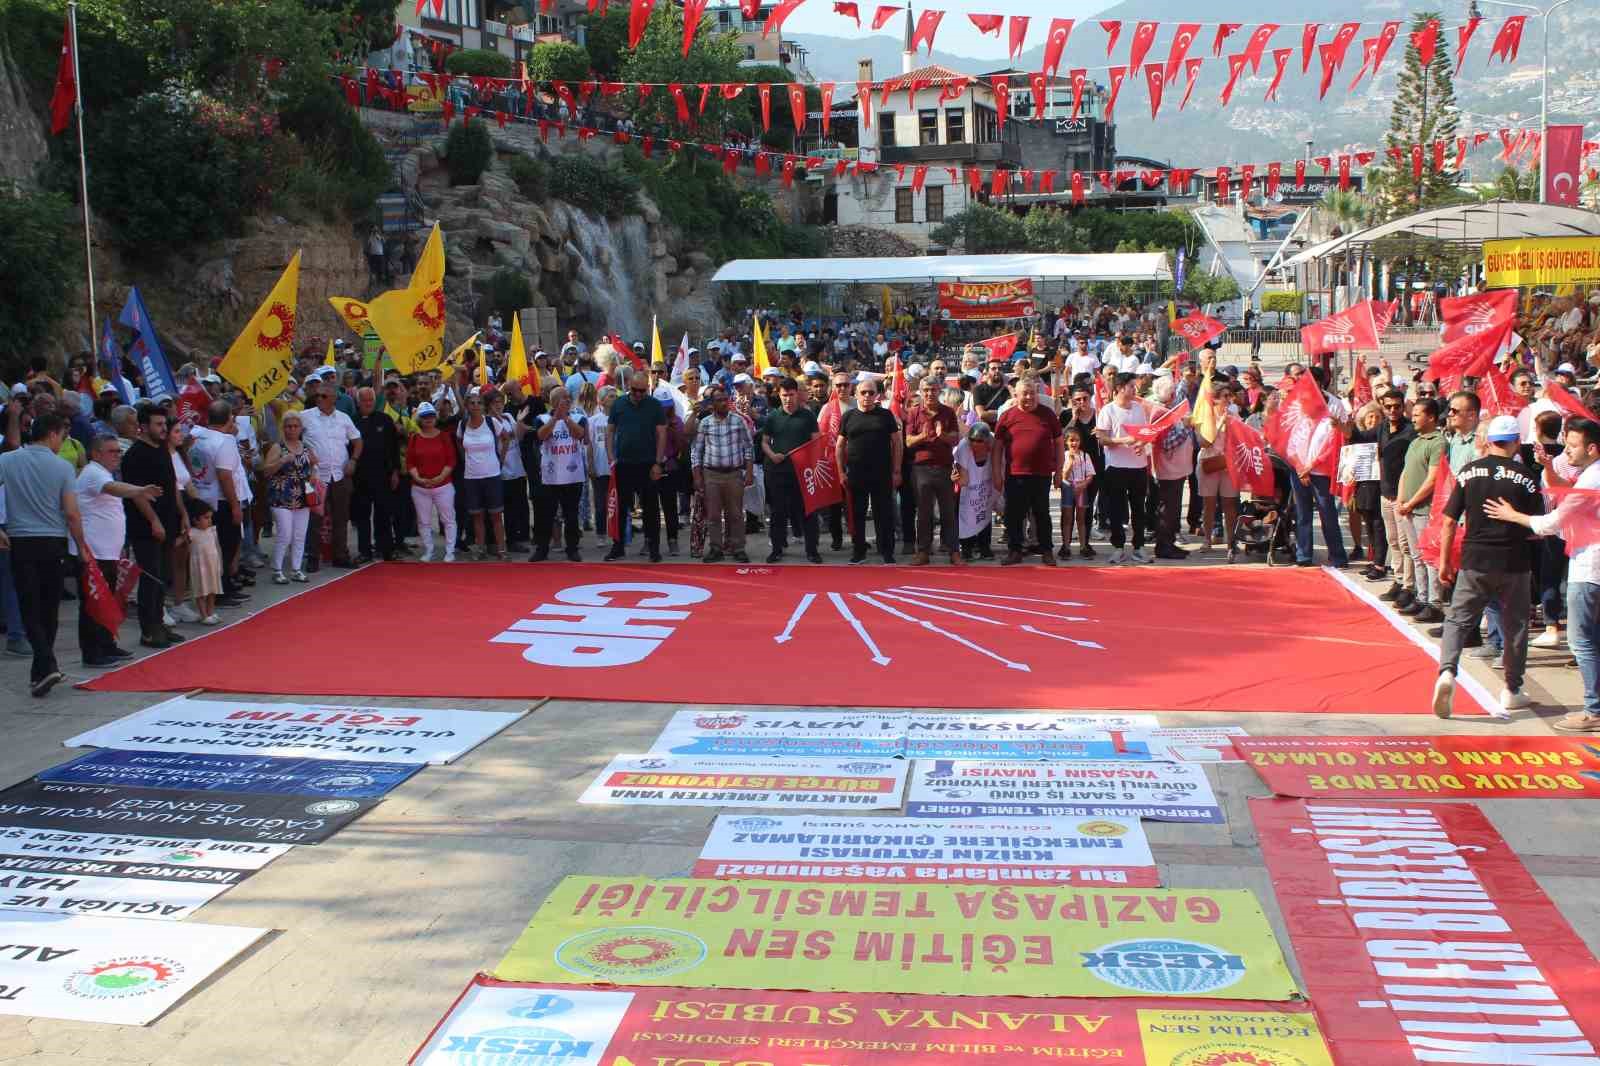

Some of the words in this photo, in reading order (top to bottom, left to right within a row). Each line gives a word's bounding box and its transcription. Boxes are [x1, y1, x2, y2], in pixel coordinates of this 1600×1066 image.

[803, 467, 816, 496] CHP
[1456, 466, 1489, 488] Palm
[1494, 465, 1536, 494] Angels
[489, 582, 712, 668] CHP
[753, 721, 864, 729] MAYIS
[1252, 752, 1357, 766] OLMAZ
[1362, 748, 1448, 766] ÇARK
[1453, 752, 1584, 768] SAĞLAM
[959, 769, 1036, 778] MAYIS!
[1047, 769, 1056, 779] 1
[1066, 769, 1159, 780] YAŞASIN
[41, 785, 120, 795] ALANYA
[622, 776, 777, 789] İSTİYORUZ
[783, 777, 880, 790] BÜTÇE
[1307, 774, 1466, 793] DÜZENDE
[1467, 774, 1585, 791] BOZUK
[611, 790, 665, 798] YANA
[672, 791, 769, 801] EMEKTEN
[990, 790, 1040, 800] GÜNÜ
[1071, 792, 1116, 800] SAAT
[111, 799, 245, 815] DERNEĞİ
[978, 806, 1034, 815] TEMEL
[1093, 807, 1214, 818] PERFORMANS
[203, 814, 325, 832] ÇAĞDAŞ
[31, 832, 89, 843] SEN
[732, 832, 935, 848] ÇIKARILAMAZ
[944, 836, 1124, 850] EMEKÇİLERE
[21, 843, 134, 857] ALANYA
[800, 847, 944, 860] FATURASI
[953, 849, 1054, 862] KRİZİN
[122, 866, 240, 884] İNSANCA
[715, 864, 907, 879] yaşanmaz!
[916, 867, 1072, 881] zamlarla
[1081, 870, 1129, 883] Bu
[0, 895, 50, 908] VE
[60, 898, 187, 916] AÇLIĞA
[573, 884, 936, 921] TEMSİLCİLİĞİ
[956, 887, 1222, 928] GAZİPAŞA
[723, 929, 834, 960] SEN
[854, 931, 1054, 973] EĞİTİM
[1081, 952, 1247, 970] KESK
[649, 1000, 857, 1030] ŞUBESİ
[872, 1008, 1112, 1034] ALANYA
[1150, 1024, 1200, 1035] SEN
[441, 1036, 594, 1058] KESK
[767, 1036, 918, 1053] EMEKÇİLERİ
[924, 1041, 997, 1057] BİLİM
[1029, 1042, 1124, 1058] EĞİTİM
